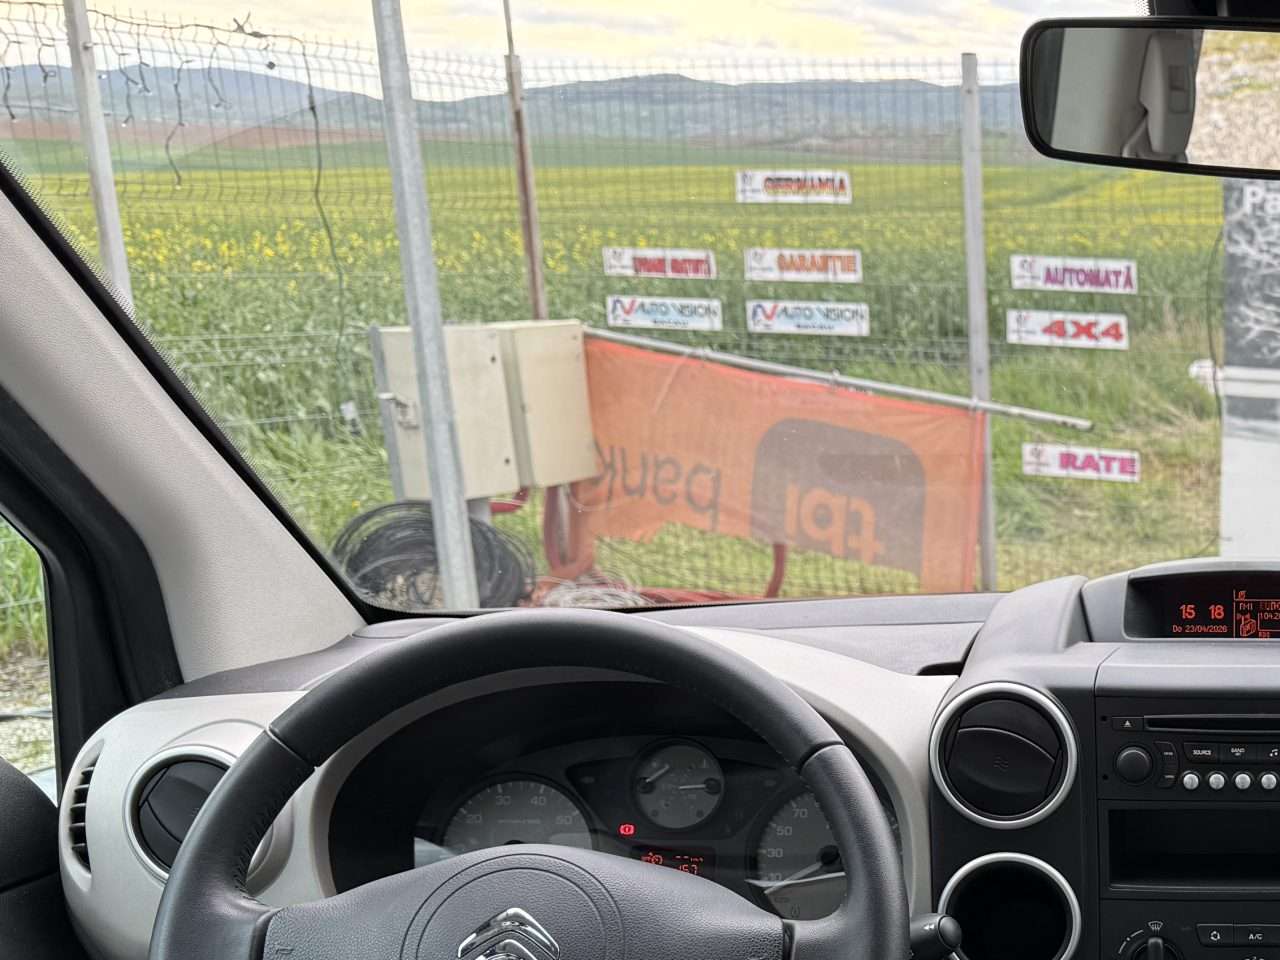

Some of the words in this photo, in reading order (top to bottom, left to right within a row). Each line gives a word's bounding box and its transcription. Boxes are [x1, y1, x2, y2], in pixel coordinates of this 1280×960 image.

[1058, 452, 1137, 476] RATE
[1178, 603, 1196, 620] 15
[1207, 603, 1225, 620] 18
